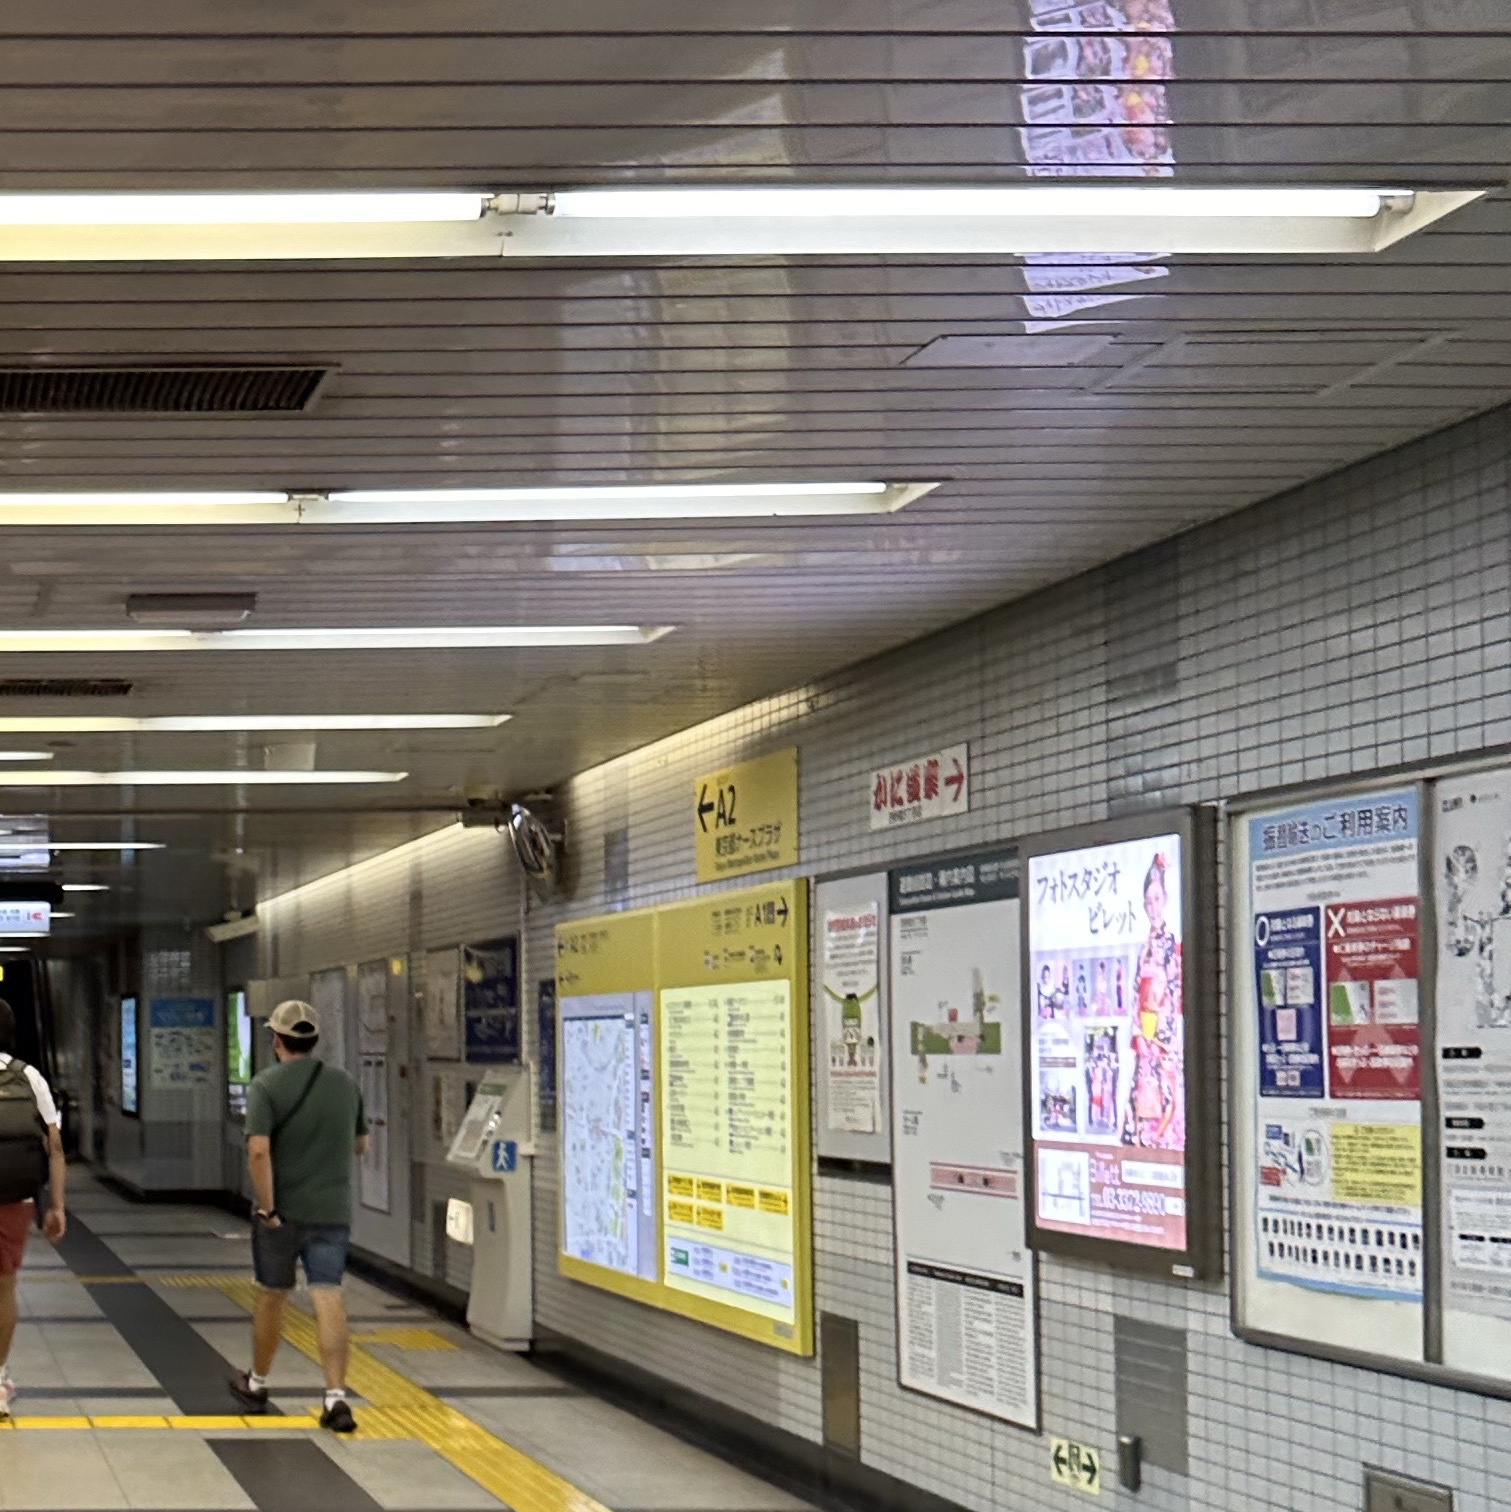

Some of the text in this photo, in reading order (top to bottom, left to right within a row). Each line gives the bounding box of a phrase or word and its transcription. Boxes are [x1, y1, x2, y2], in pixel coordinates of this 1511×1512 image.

[715, 784, 736, 829] A2
[1037, 861, 1121, 905] フォトスタジオ
[1088, 900, 1136, 935] ビレット
